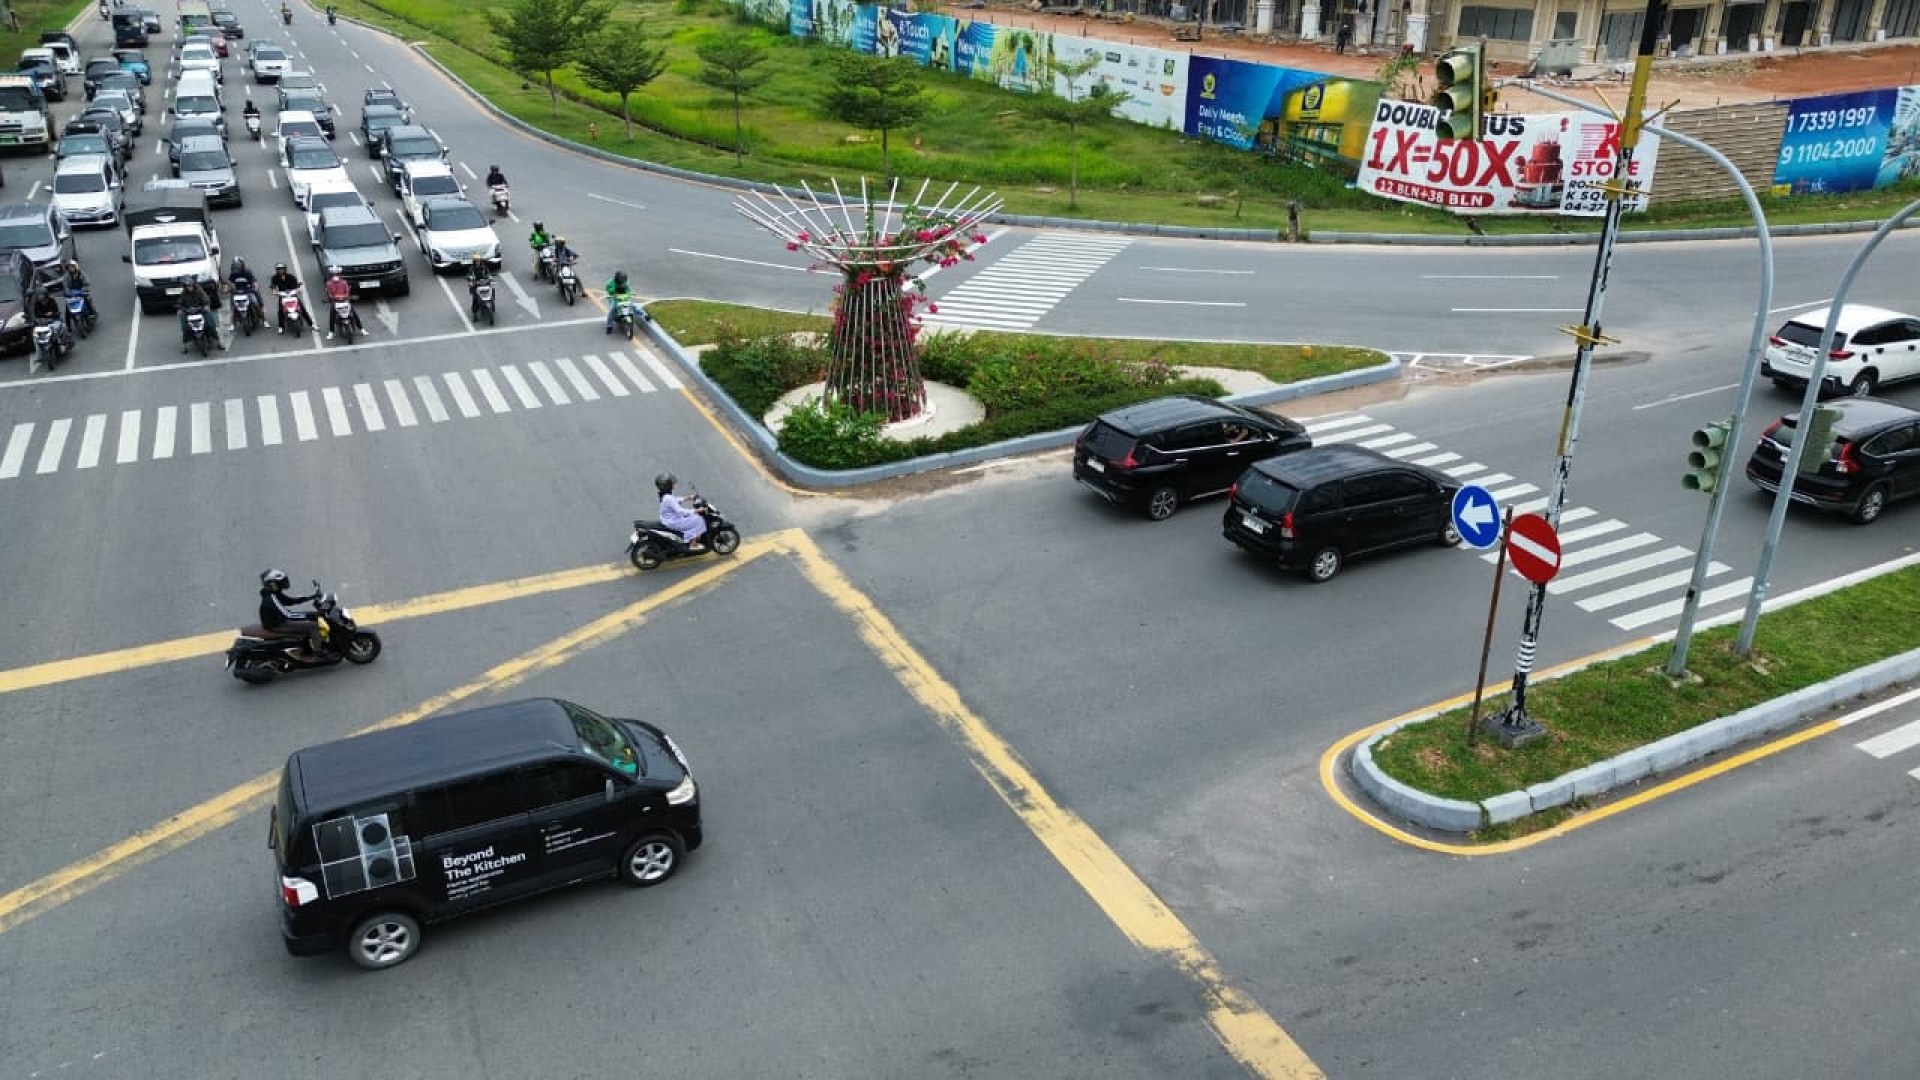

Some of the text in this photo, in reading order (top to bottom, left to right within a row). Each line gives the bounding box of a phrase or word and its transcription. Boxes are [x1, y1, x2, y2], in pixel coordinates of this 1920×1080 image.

[1199, 105, 1218, 122] Daily
[1377, 103, 1442, 129] DOUBL
[1798, 107, 1876, 133] 73391997
[1367, 126, 1521, 187] 1X=50X
[1797, 137, 1876, 163] 11042000
[1571, 161, 1639, 176] STOE
[1379, 180, 1393, 192] 12
[1448, 194, 1483, 206] BLN
[1565, 191, 1576, 200] K
[443, 845, 494, 868] Beyond
[444, 868, 471, 881] The
[474, 853, 526, 874] Kitchen
